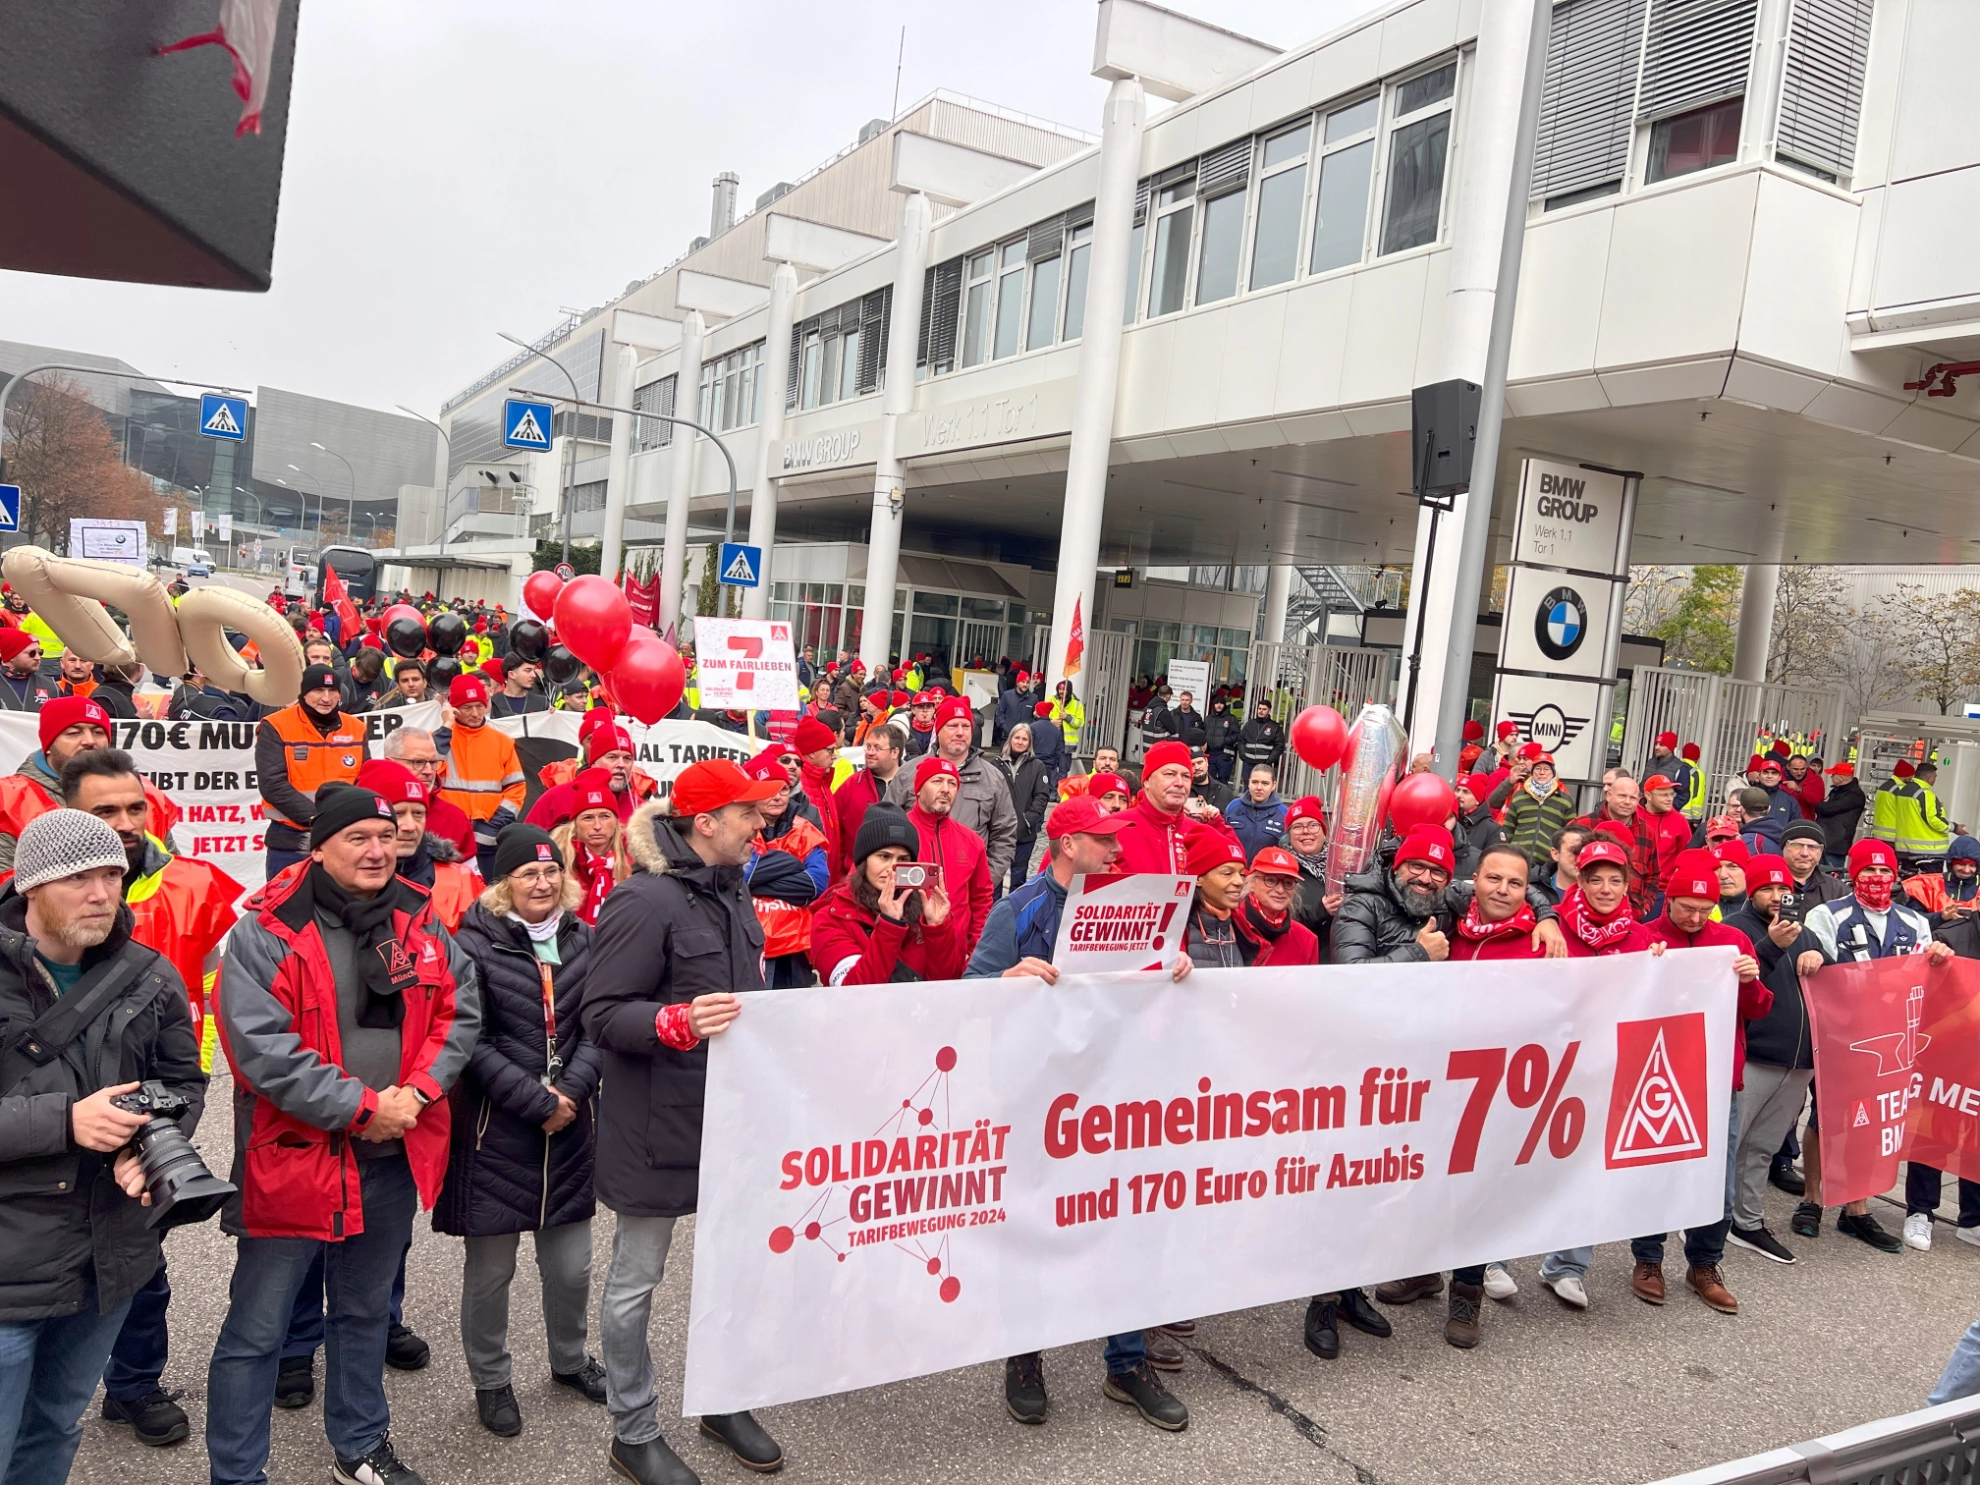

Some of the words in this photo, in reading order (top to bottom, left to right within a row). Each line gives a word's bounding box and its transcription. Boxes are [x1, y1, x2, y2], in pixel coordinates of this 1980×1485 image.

[923, 414, 961, 447] Werk
[966, 403, 990, 440] 1.1
[995, 399, 1023, 435] Tor
[1029, 394, 1038, 429] 1
[784, 438, 815, 469] BMW
[814, 430, 861, 464] GROUP
[1539, 473, 1587, 500] BMW
[1536, 496, 1599, 524] GROUP
[1534, 525, 1557, 540] Werk
[1560, 529, 1573, 542] 1.1
[1533, 540, 1549, 555] Tor
[1549, 544, 1555, 556] 1
[1544, 588, 1587, 615] BMW
[702, 659, 727, 669] ZUM
[729, 660, 792, 671] FAIRLIEBEN
[1534, 722, 1562, 738] MINI
[194, 771, 239, 790] DER
[189, 805, 246, 825] HATZ,
[192, 836, 248, 857] JETZT
[1074, 902, 1161, 920] SOLIDARITÄT
[1070, 921, 1157, 942] GEWINNT
[1069, 943, 1129, 952] TARIFBEWEGUNG
[1128, 942, 1149, 952] JETZT
[1043, 1075, 1347, 1161] Gemeinsam
[1359, 1067, 1431, 1128] für
[1444, 1040, 1587, 1176] 7%
[780, 1118, 1012, 1191] SOLIDARITÄT
[849, 1165, 1008, 1224] GEWINNT
[1055, 1177, 1119, 1227] und
[1126, 1170, 1187, 1214] 170
[1194, 1161, 1268, 1206] Euro
[1274, 1155, 1321, 1196] für
[1325, 1143, 1425, 1190] Azubis
[847, 1212, 967, 1248] TARIFBEWEGUNG
[969, 1208, 1007, 1226] 2024
